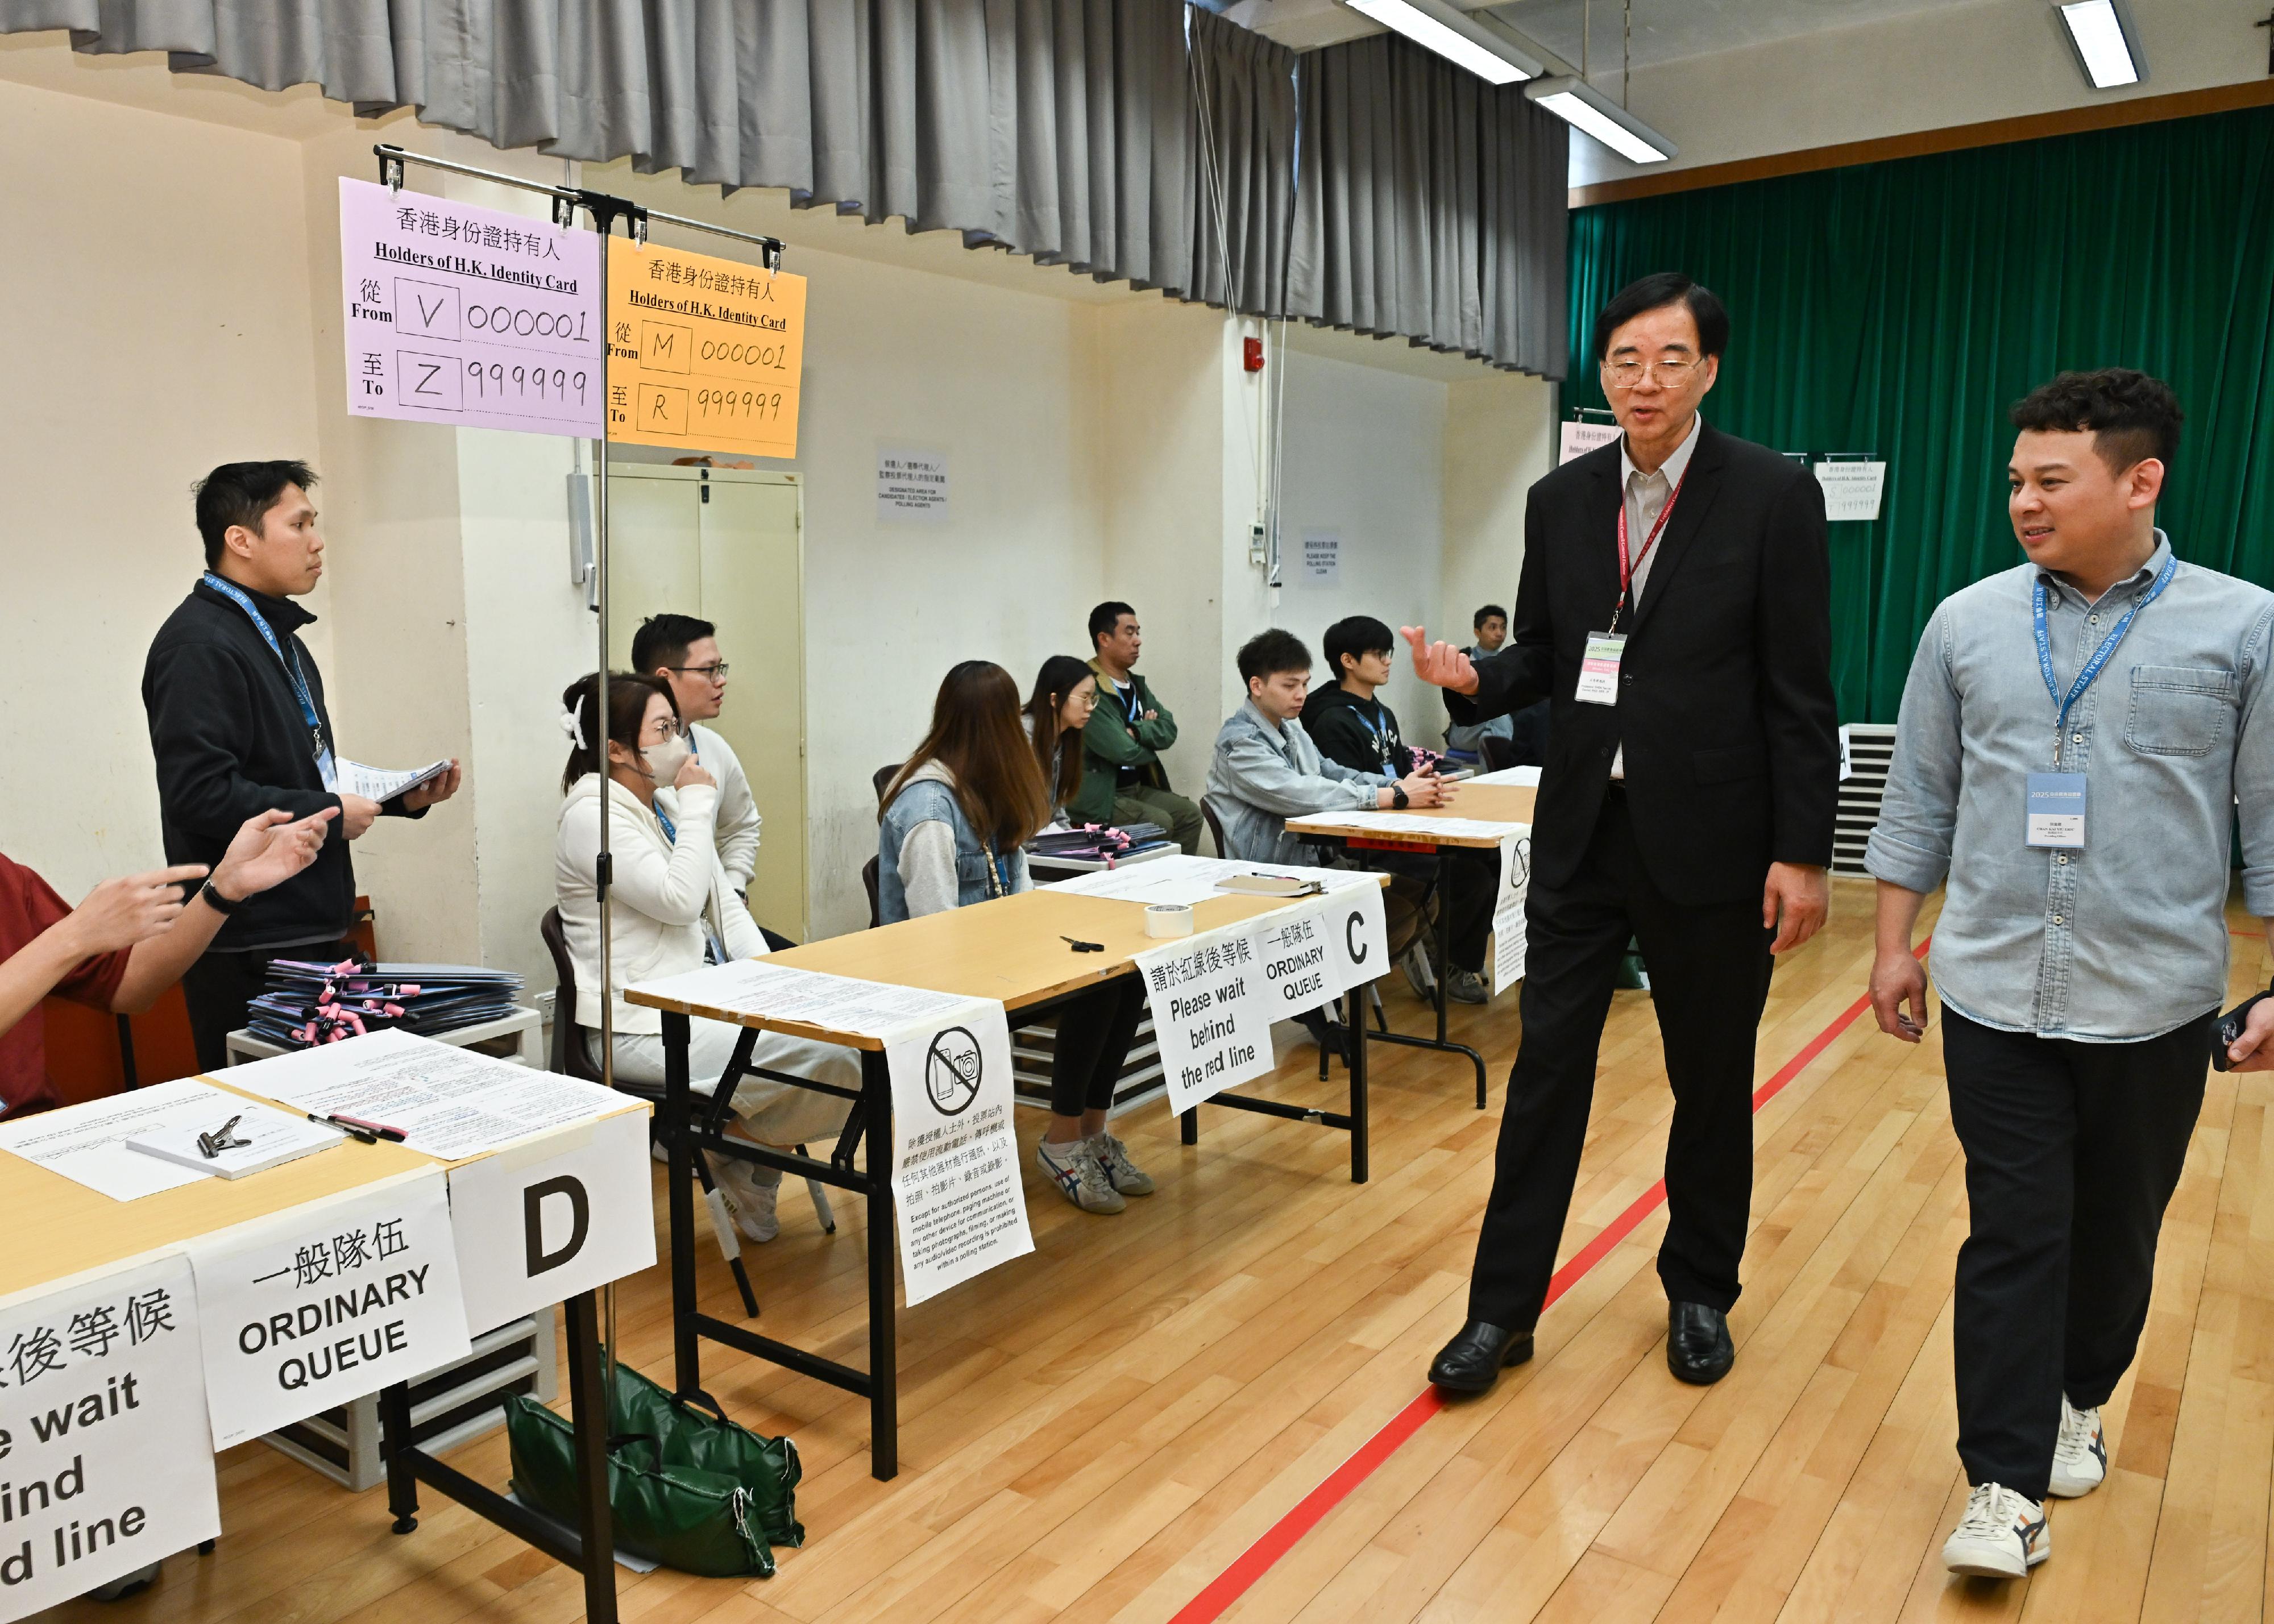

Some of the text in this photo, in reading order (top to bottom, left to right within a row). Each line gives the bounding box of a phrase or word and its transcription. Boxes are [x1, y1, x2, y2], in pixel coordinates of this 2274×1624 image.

[397, 207, 561, 261] 香港身份證持有人
[375, 241, 578, 293] Holders of H.K. Identity Card
[649, 259, 774, 302] 香港身份證持有人
[351, 302, 392, 323] From
[360, 277, 381, 304] 從
[629, 289, 786, 330] Holders of H.K. Identity Card
[417, 294, 590, 342] V 000001
[615, 321, 632, 343] 從
[362, 352, 384, 376] 至
[607, 343, 638, 360] From
[653, 333, 786, 369] M 000001
[363, 379, 383, 396] To
[414, 361, 587, 406] Z 999999
[611, 385, 627, 406] 至
[653, 389, 781, 421] R 999999
[610, 409, 625, 422] To
[2037, 629, 2045, 652] STAFF
[2070, 633, 2118, 699] ELECTORAL STAFF
[1267, 919, 1314, 950] 一般隊伍
[1346, 911, 1367, 965] C
[1150, 938, 1252, 994] 請於紅線後等候
[1266, 945, 1324, 980] ORDINARY
[1170, 976, 1246, 1023] Please wait
[1283, 972, 1323, 1001] QUEUE
[1190, 1013, 1235, 1050] behind
[1181, 1043, 1255, 1090] the red line
[910, 1208, 931, 1223] Except
[941, 1193, 969, 1210] authorized
[970, 1184, 994, 1198] persons,
[994, 1178, 1004, 1187] use
[1004, 1175, 1010, 1184] of
[912, 1220, 932, 1235] mobile
[962, 1199, 981, 1214] paging
[981, 1190, 1004, 1205] machine
[523, 1174, 590, 1279] D
[910, 1237, 922, 1248] any
[922, 1230, 938, 1241] other
[939, 1222, 957, 1236] device
[957, 1218, 966, 1227] for
[912, 1244, 931, 1259] taking
[995, 1207, 1015, 1222] making
[914, 1261, 924, 1270] any
[925, 1245, 957, 1264] audio/video
[958, 1232, 984, 1249] recording
[990, 1218, 1018, 1235] prohibited
[252, 1217, 410, 1290] 一般隊伍
[937, 1259, 954, 1271] within
[960, 1248, 978, 1261] polling
[978, 1239, 998, 1252] station.
[238, 1263, 431, 1356] ORDINARY
[0, 1287, 176, 1389] 後等候
[279, 1319, 408, 1392] QUEUE
[30, 1372, 139, 1444] wait
[0, 1454, 85, 1524] ind
[56, 1505, 146, 1568] line
